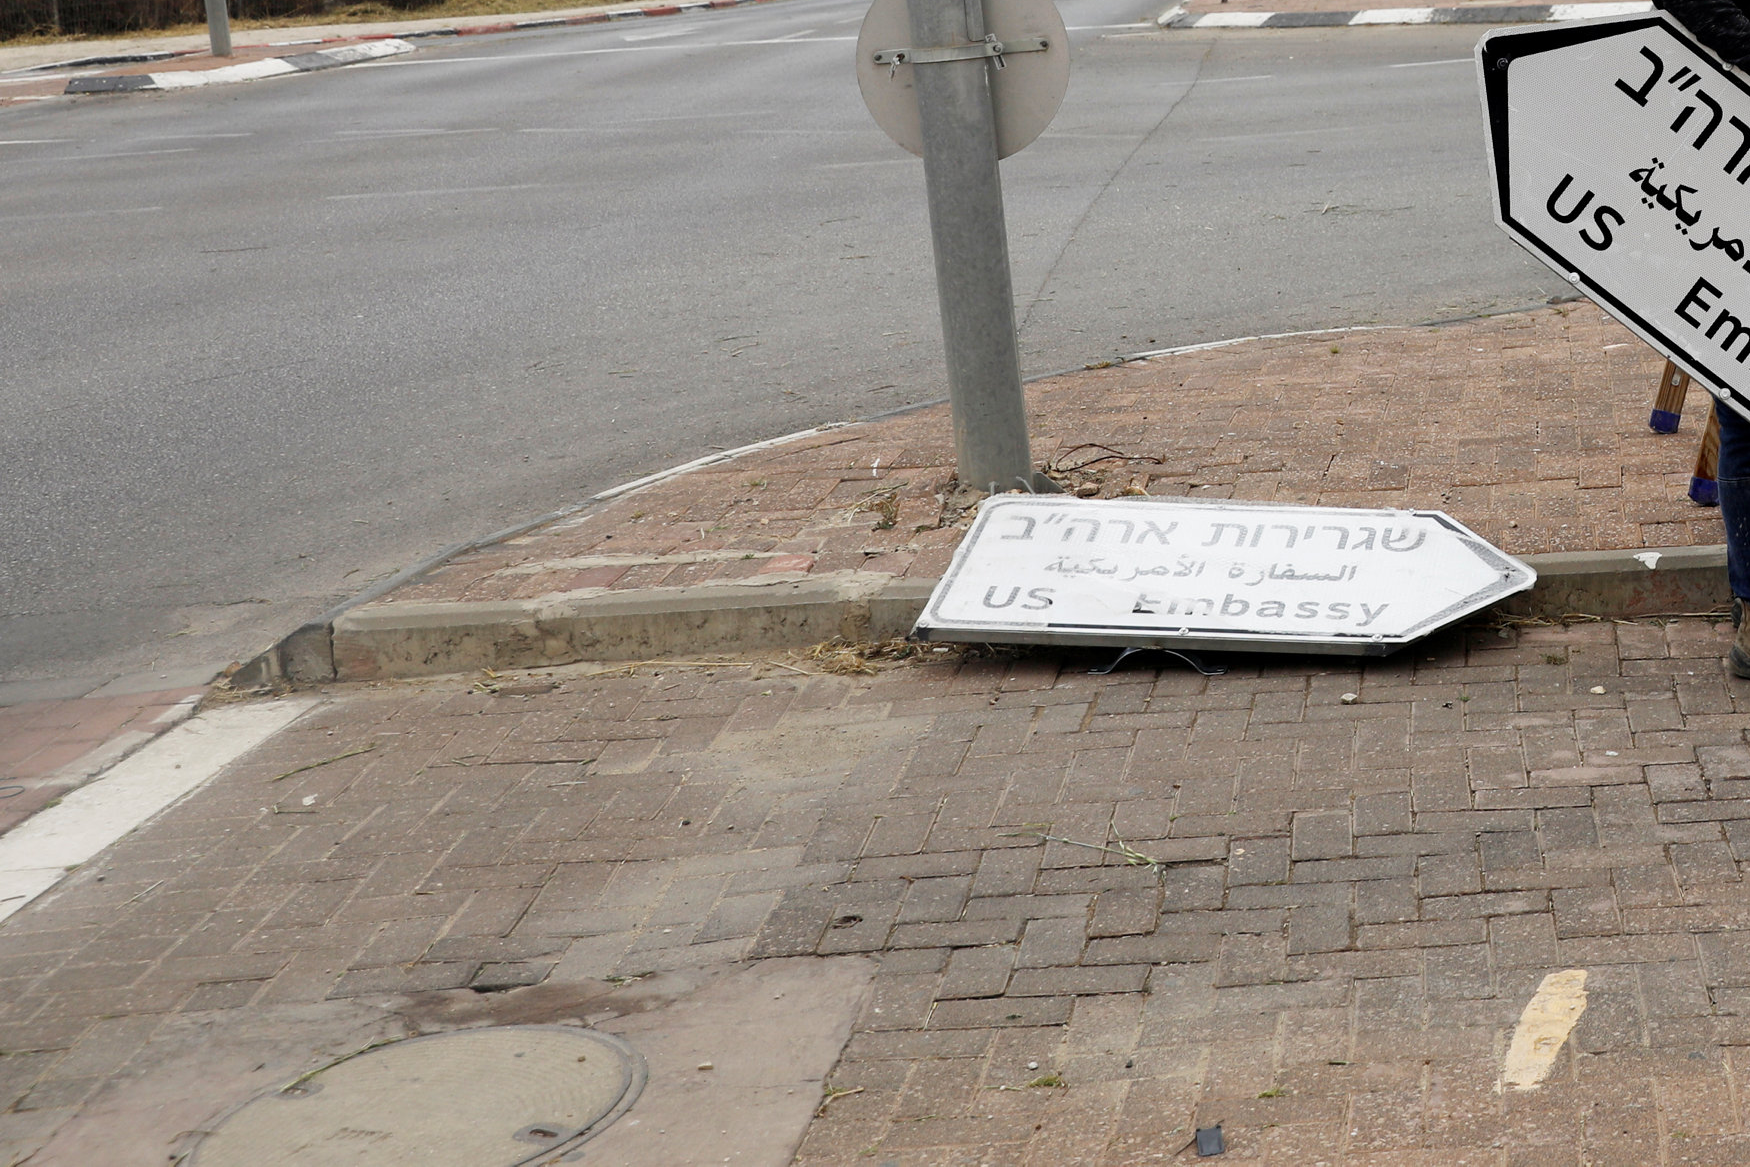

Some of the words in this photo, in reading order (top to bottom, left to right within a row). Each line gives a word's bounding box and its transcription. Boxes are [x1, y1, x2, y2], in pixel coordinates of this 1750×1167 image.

[1545, 173, 1626, 252] US
[1000, 514, 1179, 544] ארה"ב
[1201, 522, 1428, 553] שגרירות
[1044, 554, 1206, 581] الأمريكية
[1228, 562, 1359, 586] السفارة
[982, 585, 1056, 611] US
[1132, 593, 1389, 627] Embassy
